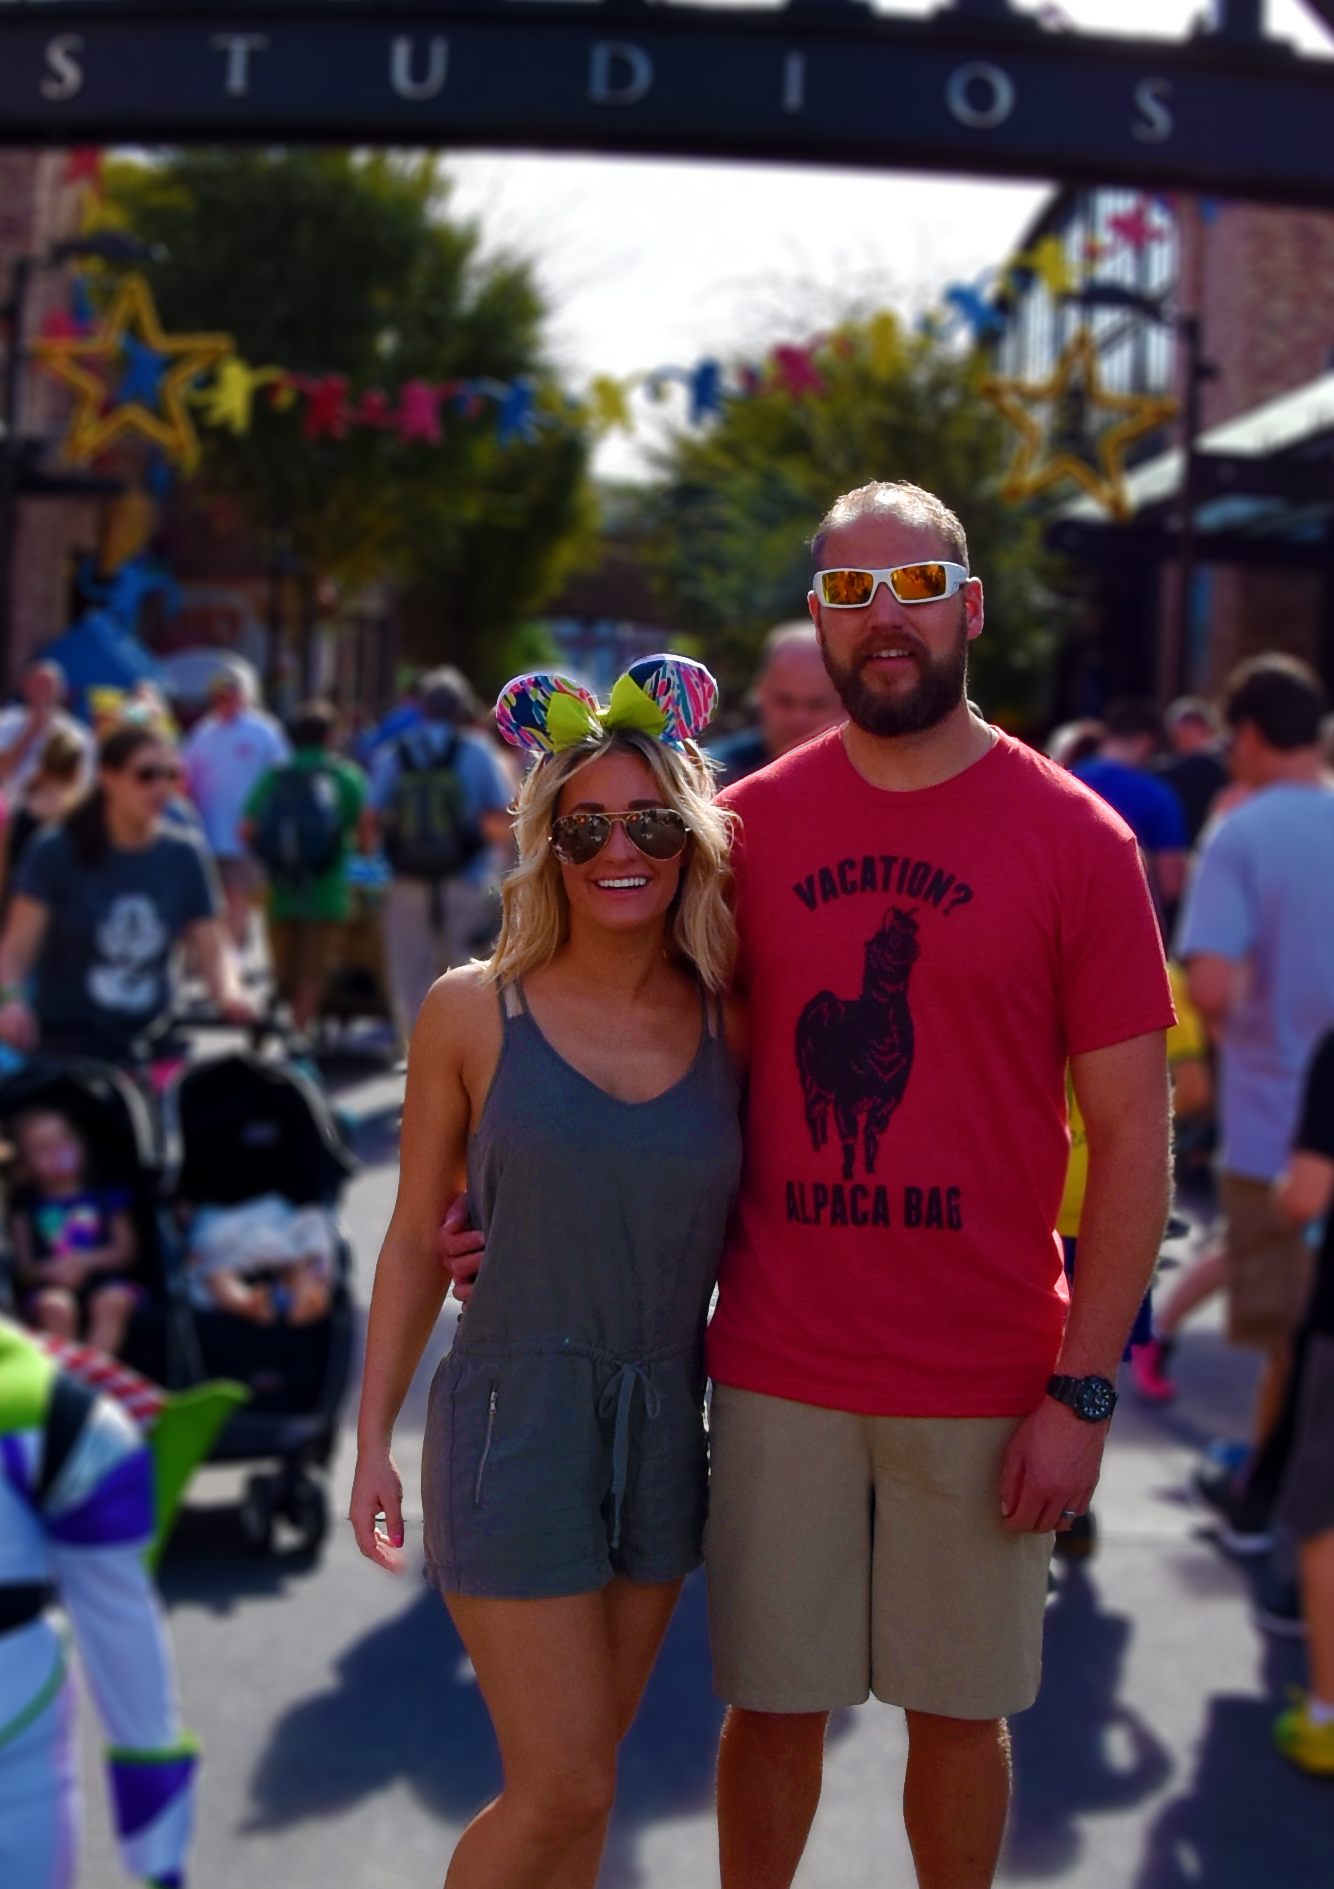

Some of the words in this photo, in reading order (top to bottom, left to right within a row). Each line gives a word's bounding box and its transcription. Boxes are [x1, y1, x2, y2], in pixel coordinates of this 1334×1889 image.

[38, 31, 1175, 145] STUDIOS
[792, 855, 973, 917] VACATION?
[785, 1179, 892, 1229] ALPACA
[903, 1185, 964, 1232] BAG
